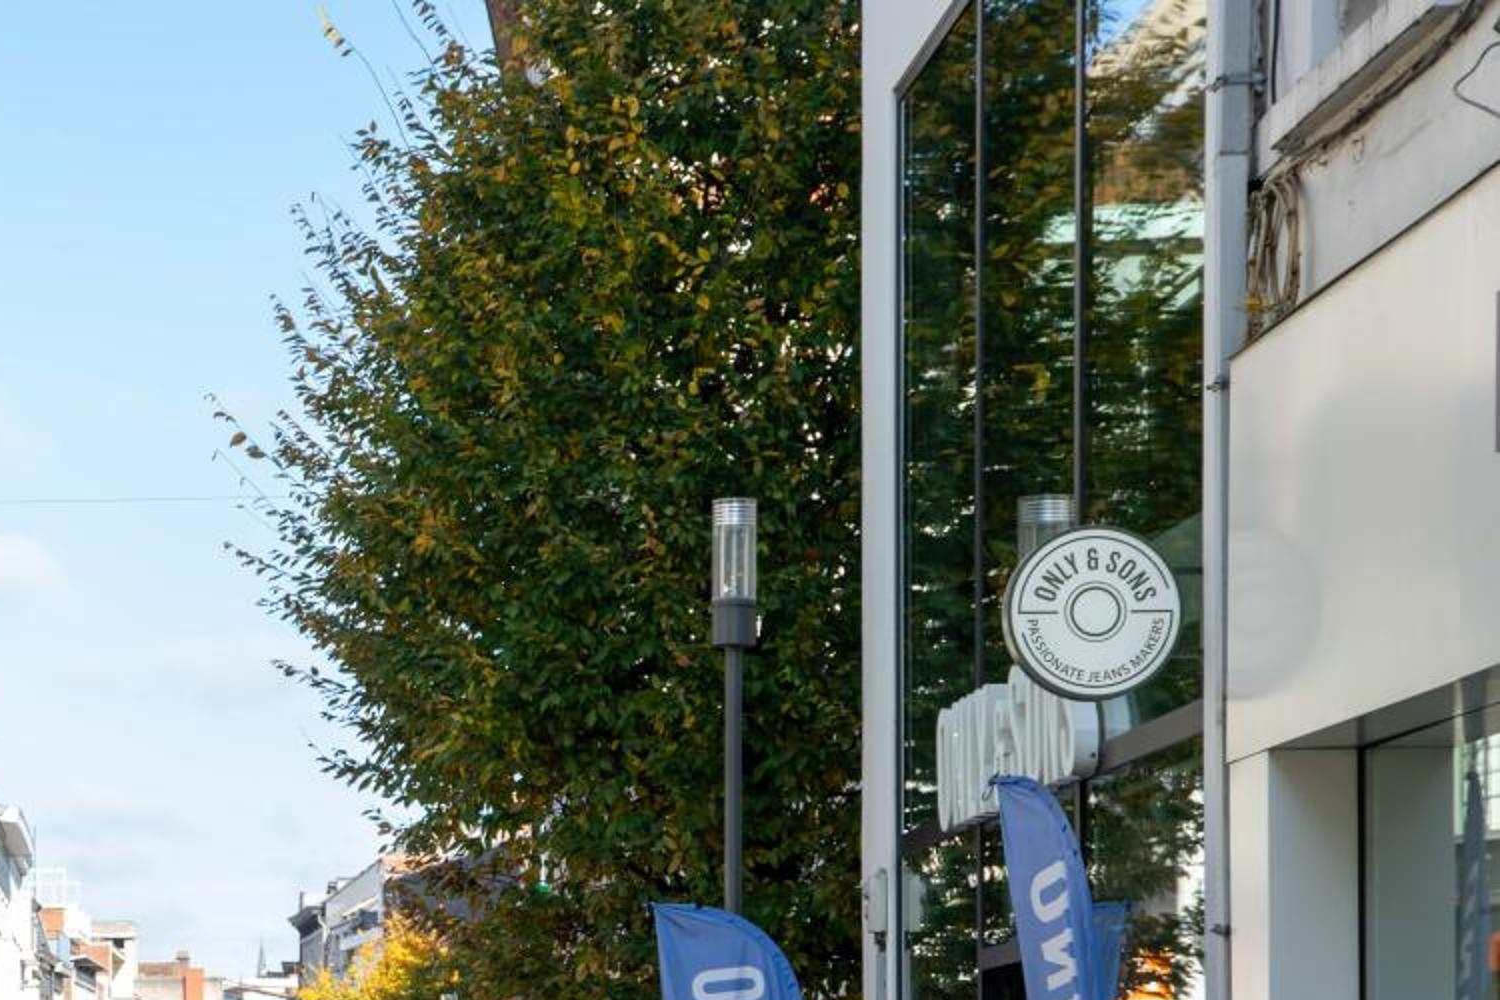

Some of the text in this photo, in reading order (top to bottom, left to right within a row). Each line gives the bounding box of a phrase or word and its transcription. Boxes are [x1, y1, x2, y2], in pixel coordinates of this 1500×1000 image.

[1034, 547, 1157, 603] ONLY & SONS
[1027, 617, 1165, 683] PASSIONATE JEANS MAKERS
